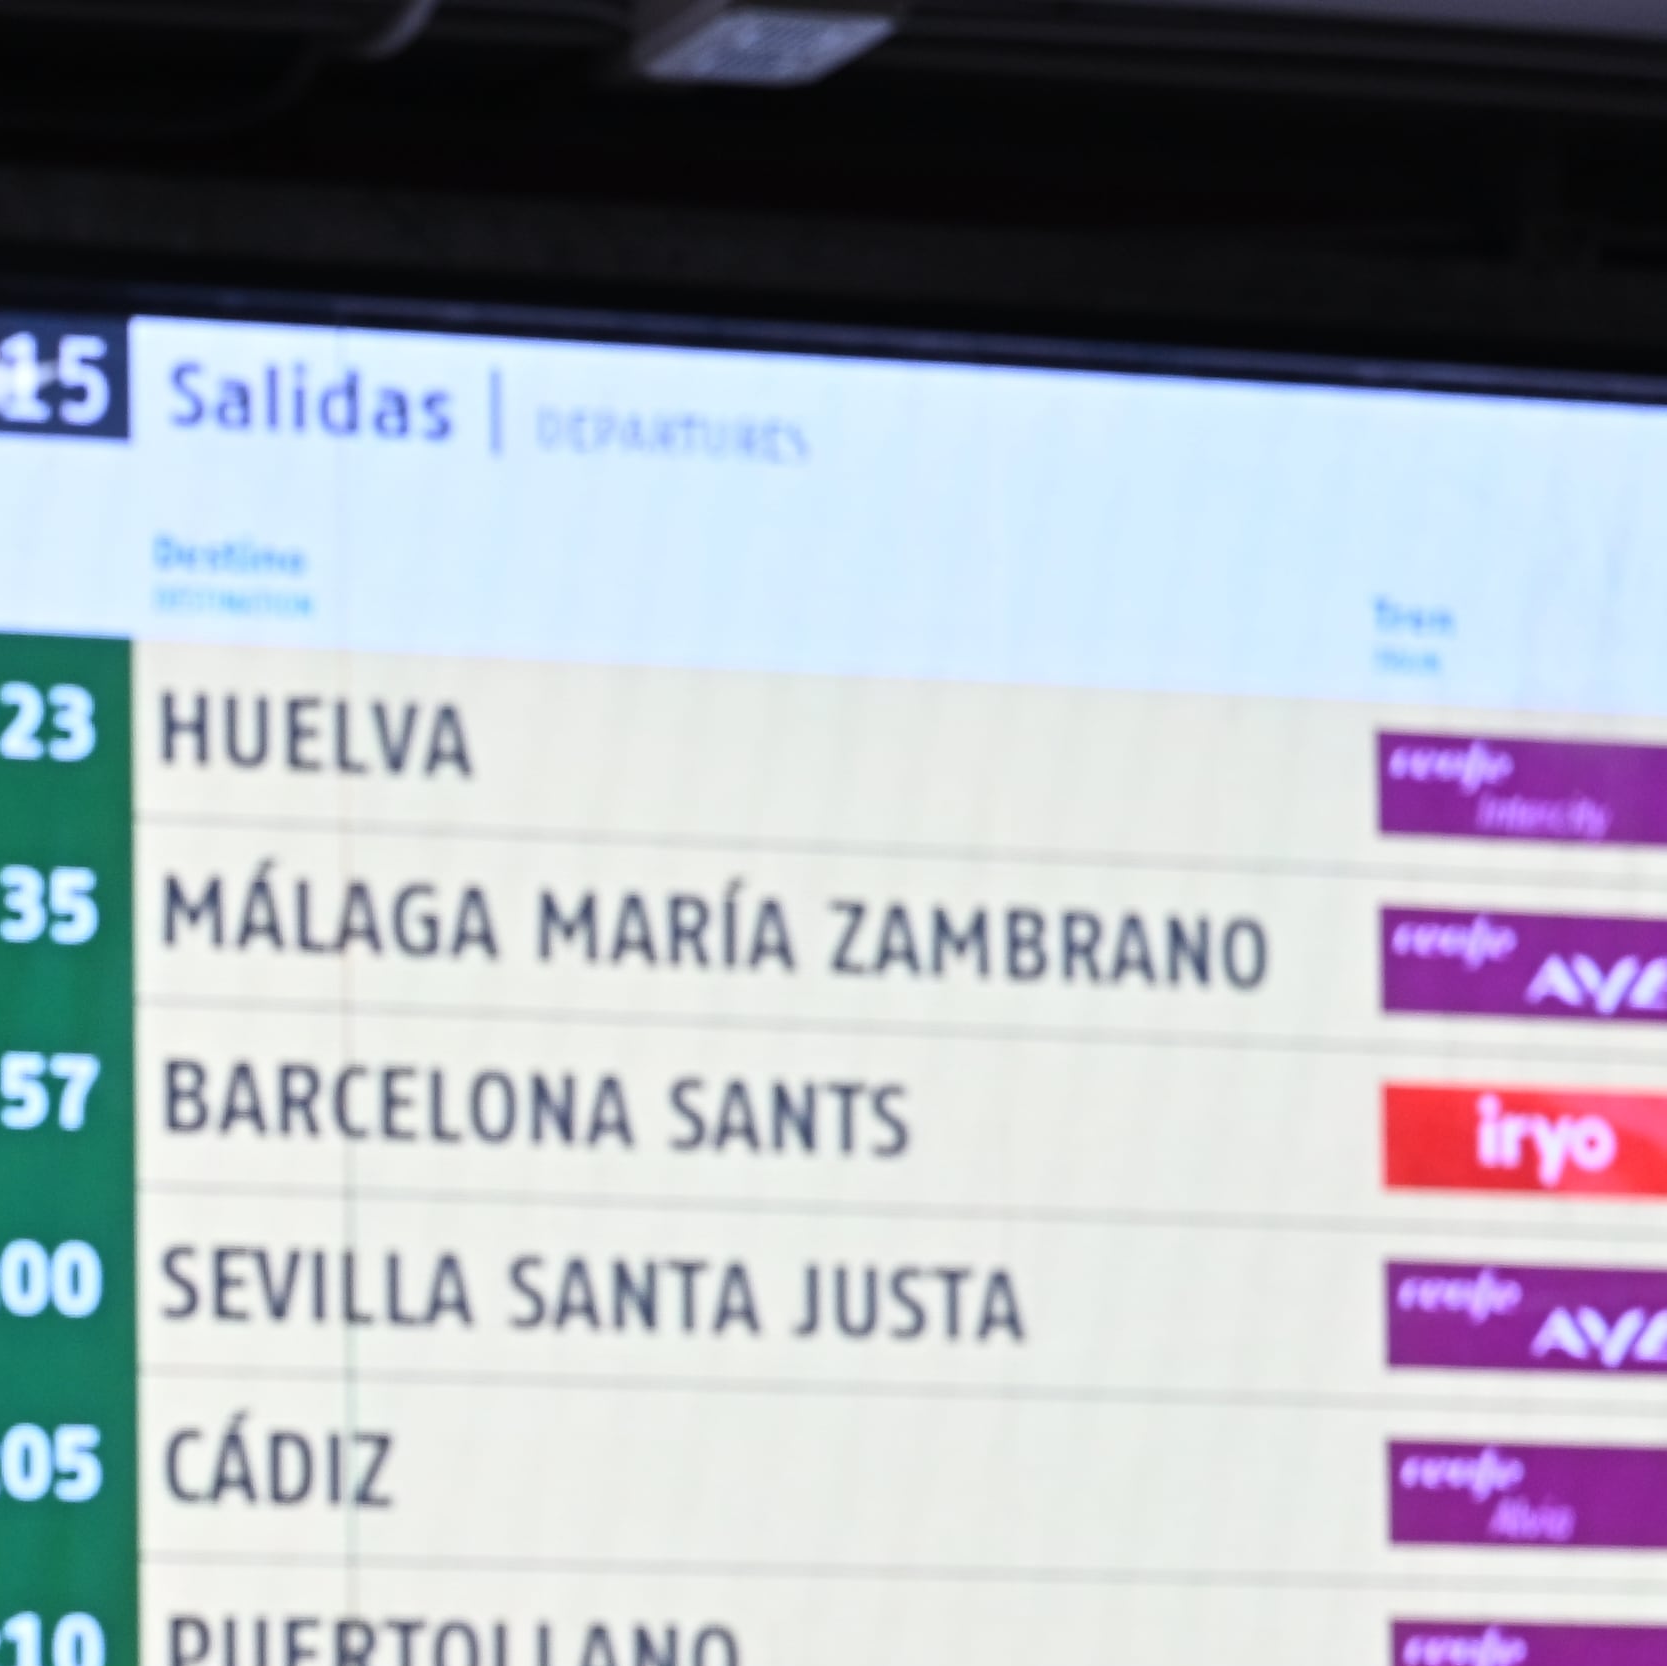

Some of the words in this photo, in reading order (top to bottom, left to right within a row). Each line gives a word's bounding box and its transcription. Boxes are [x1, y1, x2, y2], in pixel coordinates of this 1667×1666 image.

[168, 359, 455, 445] Salidas
[158, 689, 474, 780] HUELVA
[161, 857, 501, 962] MÁLAGA
[536, 877, 798, 974] MARÍA
[828, 899, 1269, 993] ZAMBRANO
[162, 1056, 636, 1150] BARCELONA
[667, 1075, 911, 1160] SANTS
[1476, 1093, 1618, 1187] iryo
[159, 1243, 476, 1330] SEVILLA
[507, 1253, 763, 1337] SANTA
[792, 1262, 1027, 1344] JUSTA
[163, 1409, 394, 1510] CÁDIZ
